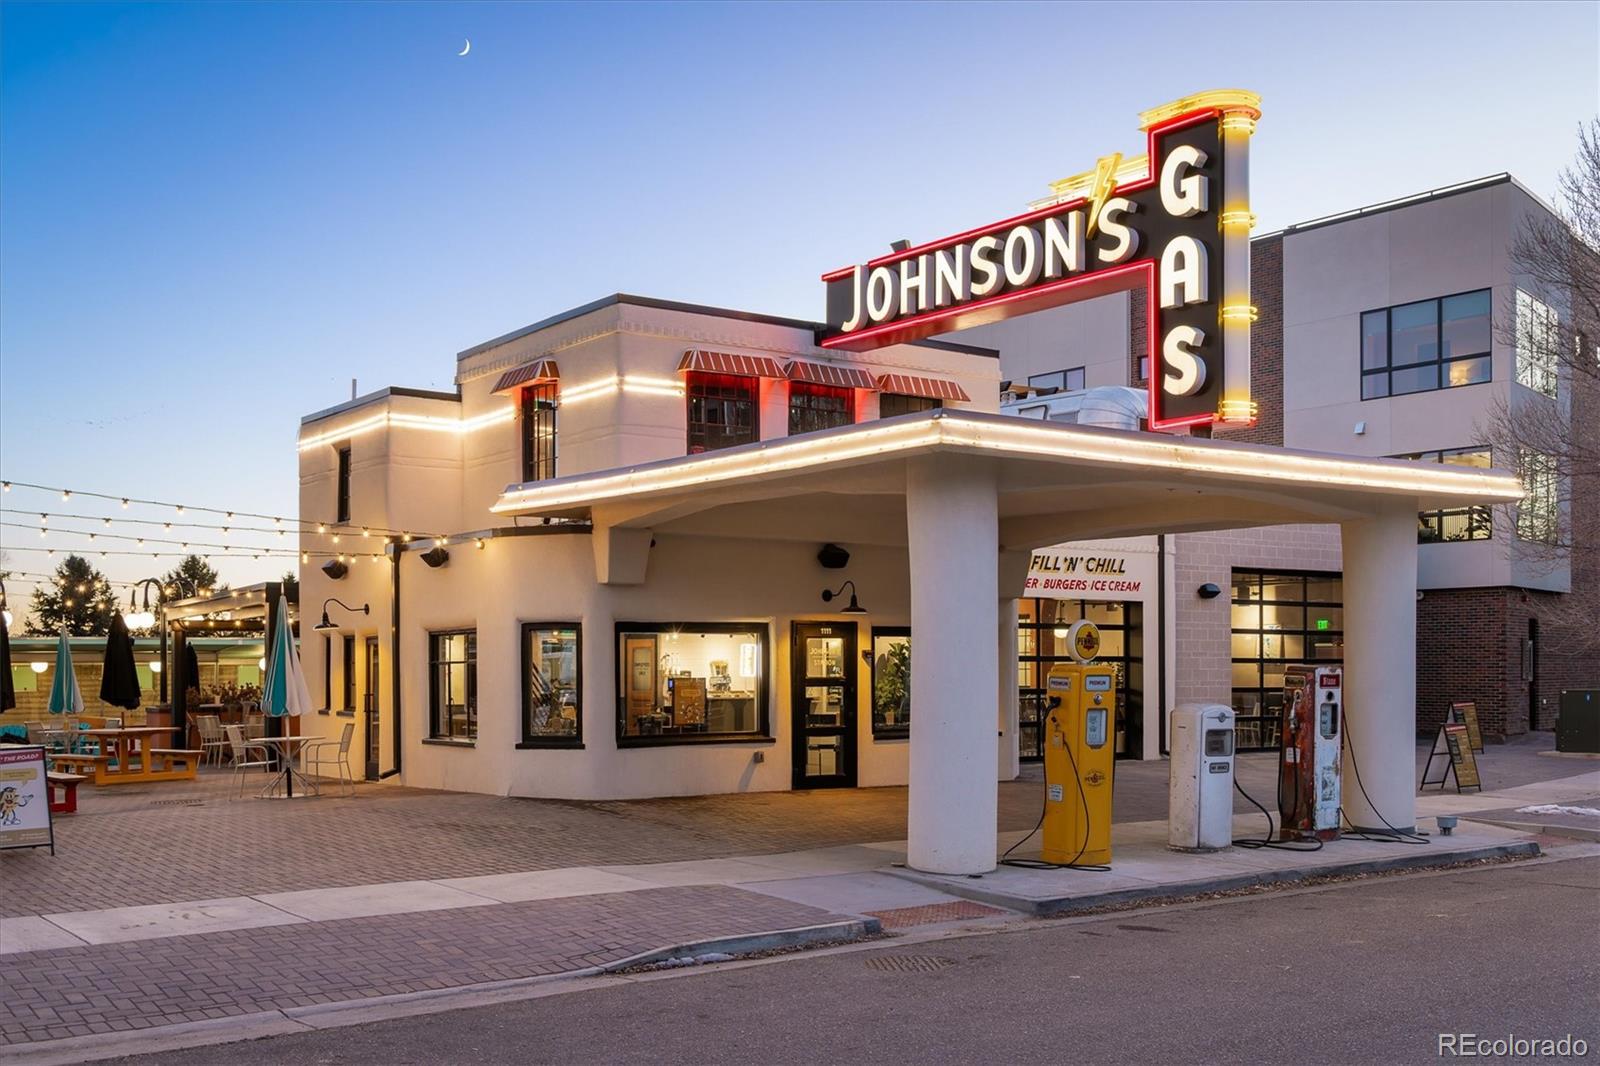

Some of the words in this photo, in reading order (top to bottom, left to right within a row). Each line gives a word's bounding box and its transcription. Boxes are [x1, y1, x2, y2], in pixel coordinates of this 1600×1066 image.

[840, 195, 1143, 334] JOHNSON'S
[1159, 144, 1210, 397] GAS
[1031, 555, 1061, 572] FILL
[1086, 557, 1126, 574] CHILL
[1043, 579, 1087, 590] BURGERS
[1090, 580, 1106, 591] ICE
[1108, 580, 1141, 592] CREAM
